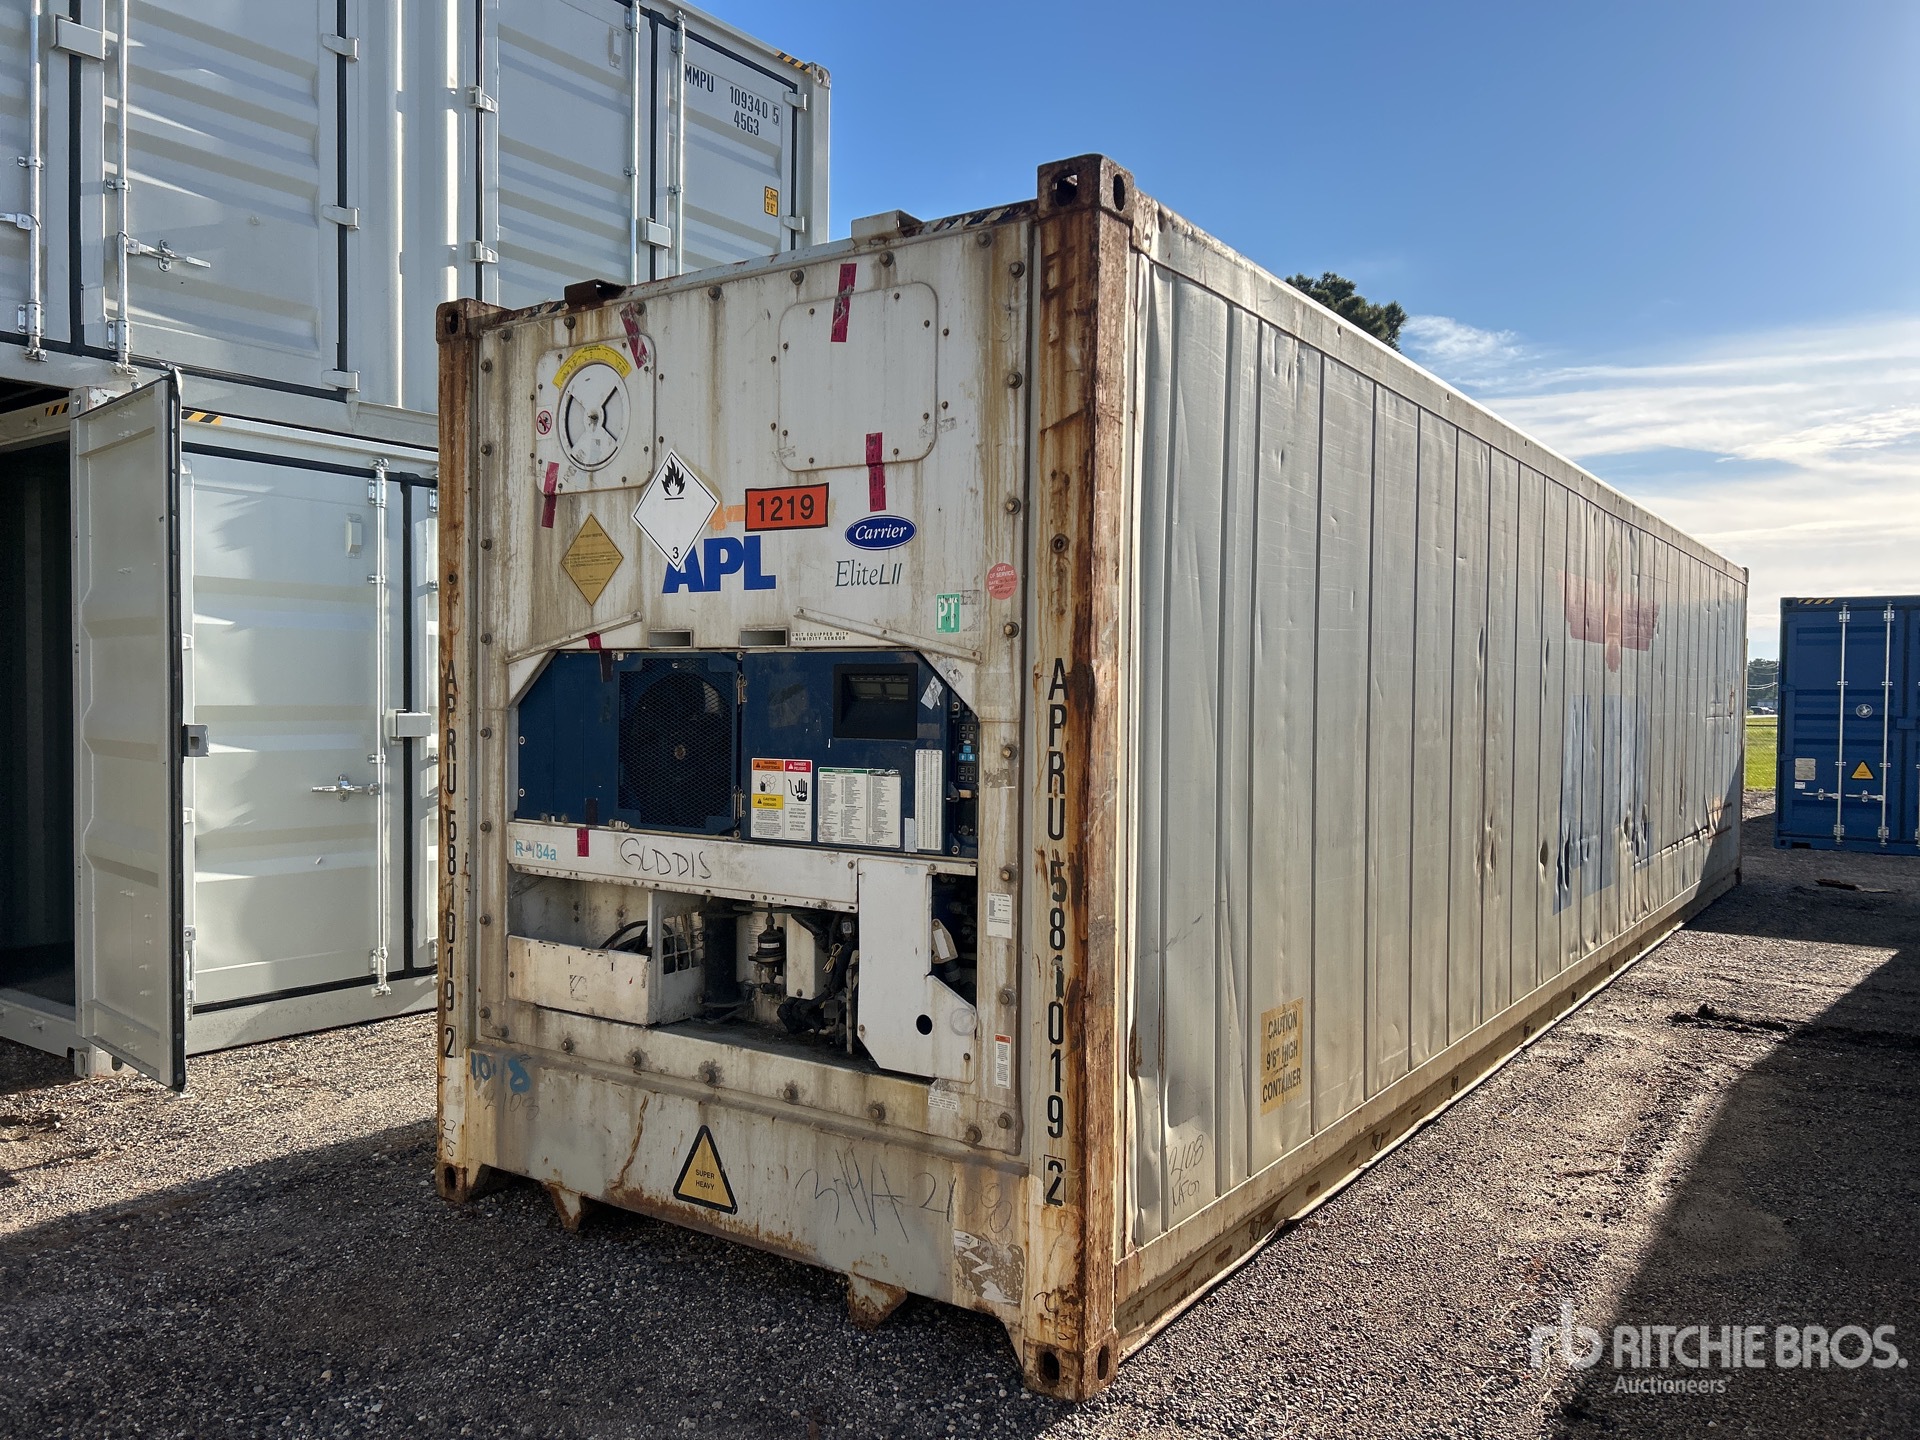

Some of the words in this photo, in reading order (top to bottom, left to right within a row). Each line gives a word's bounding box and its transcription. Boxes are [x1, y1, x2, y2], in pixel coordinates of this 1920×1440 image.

[684, 64, 715, 93] MMPU
[729, 85, 768, 119] 109340
[733, 110, 760, 136] 45G3
[757, 494, 815, 522] 1219
[855, 524, 907, 541] Carrier
[661, 534, 777, 594] APL
[671, 546, 680, 560] 3
[996, 570, 1015, 578] SERVICE
[1047, 657, 1069, 841] APRU
[1267, 1010, 1298, 1040] CAUTION
[1262, 1066, 1302, 1104] CONTAINER
[695, 1168, 715, 1180] SUPER
[695, 1180, 715, 1191] HEAVY
